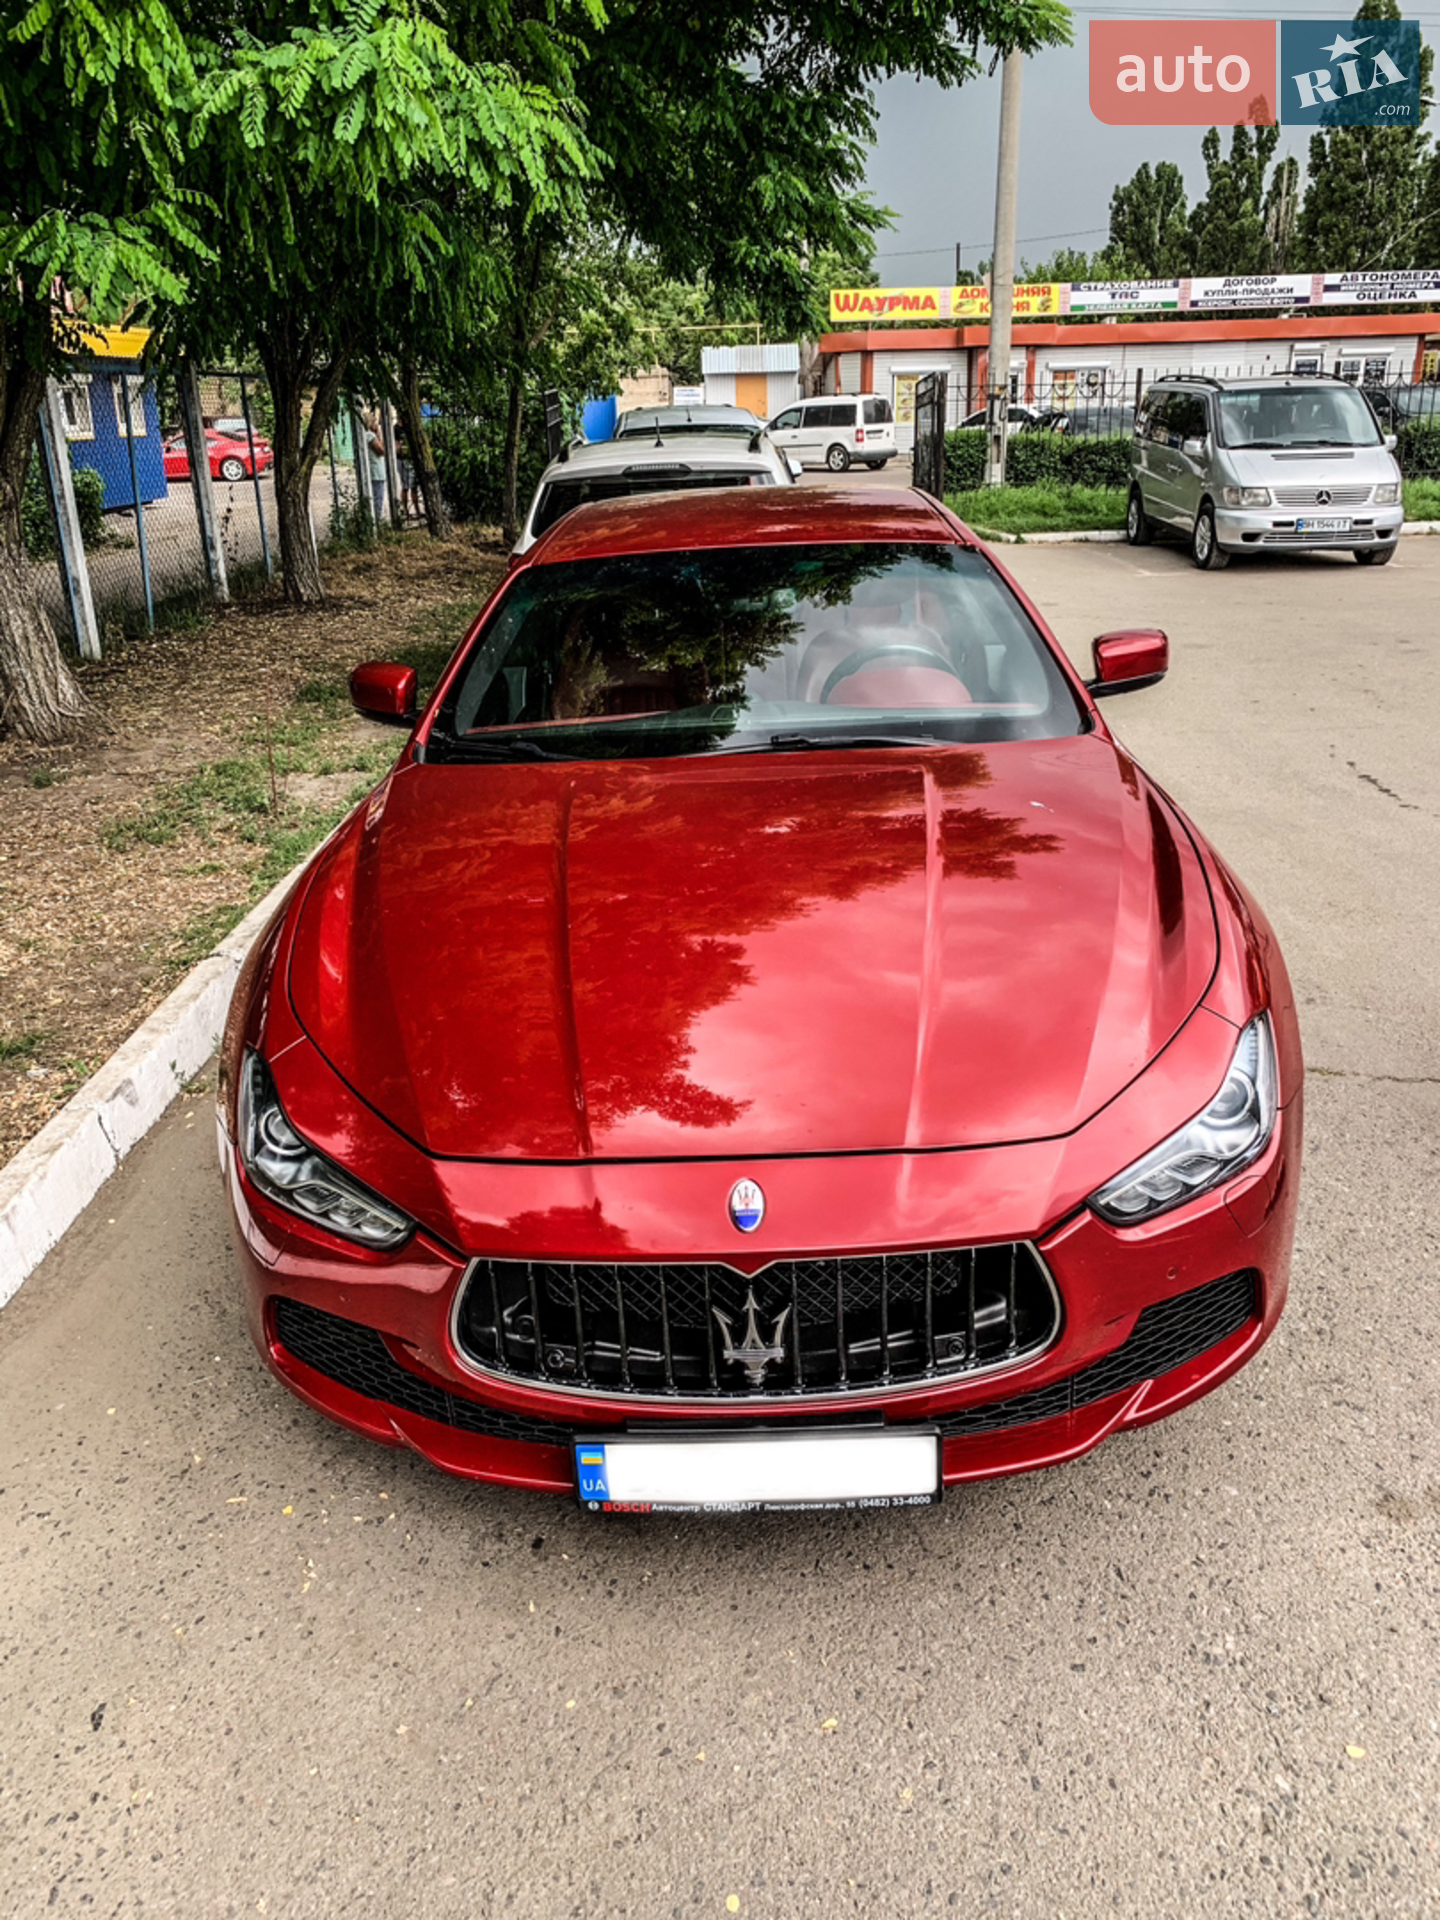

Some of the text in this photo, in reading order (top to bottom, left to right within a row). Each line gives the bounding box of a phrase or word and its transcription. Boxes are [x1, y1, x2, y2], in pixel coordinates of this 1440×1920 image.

[1222, 277, 1277, 287] ДОГОВОР
[1340, 272, 1440, 282] АВТОНОМЕРА
[1080, 280, 1174, 291] СТРАХОВАНИЕ
[959, 285, 1051, 299] ДОМШНЯЯ
[1203, 287, 1294, 297] КУПЛИ-ПРОДАЖИ
[1356, 291, 1417, 301] ОЦЕНКА
[980, 301, 1030, 313] КНЯ
[582, 1479, 606, 1492] UA
[603, 1501, 651, 1512] BOSCH
[651, 1503, 700, 1513] Автоцентр
[703, 1502, 761, 1512] СТАНДАРТ
[892, 1495, 931, 1506] 33-4000
